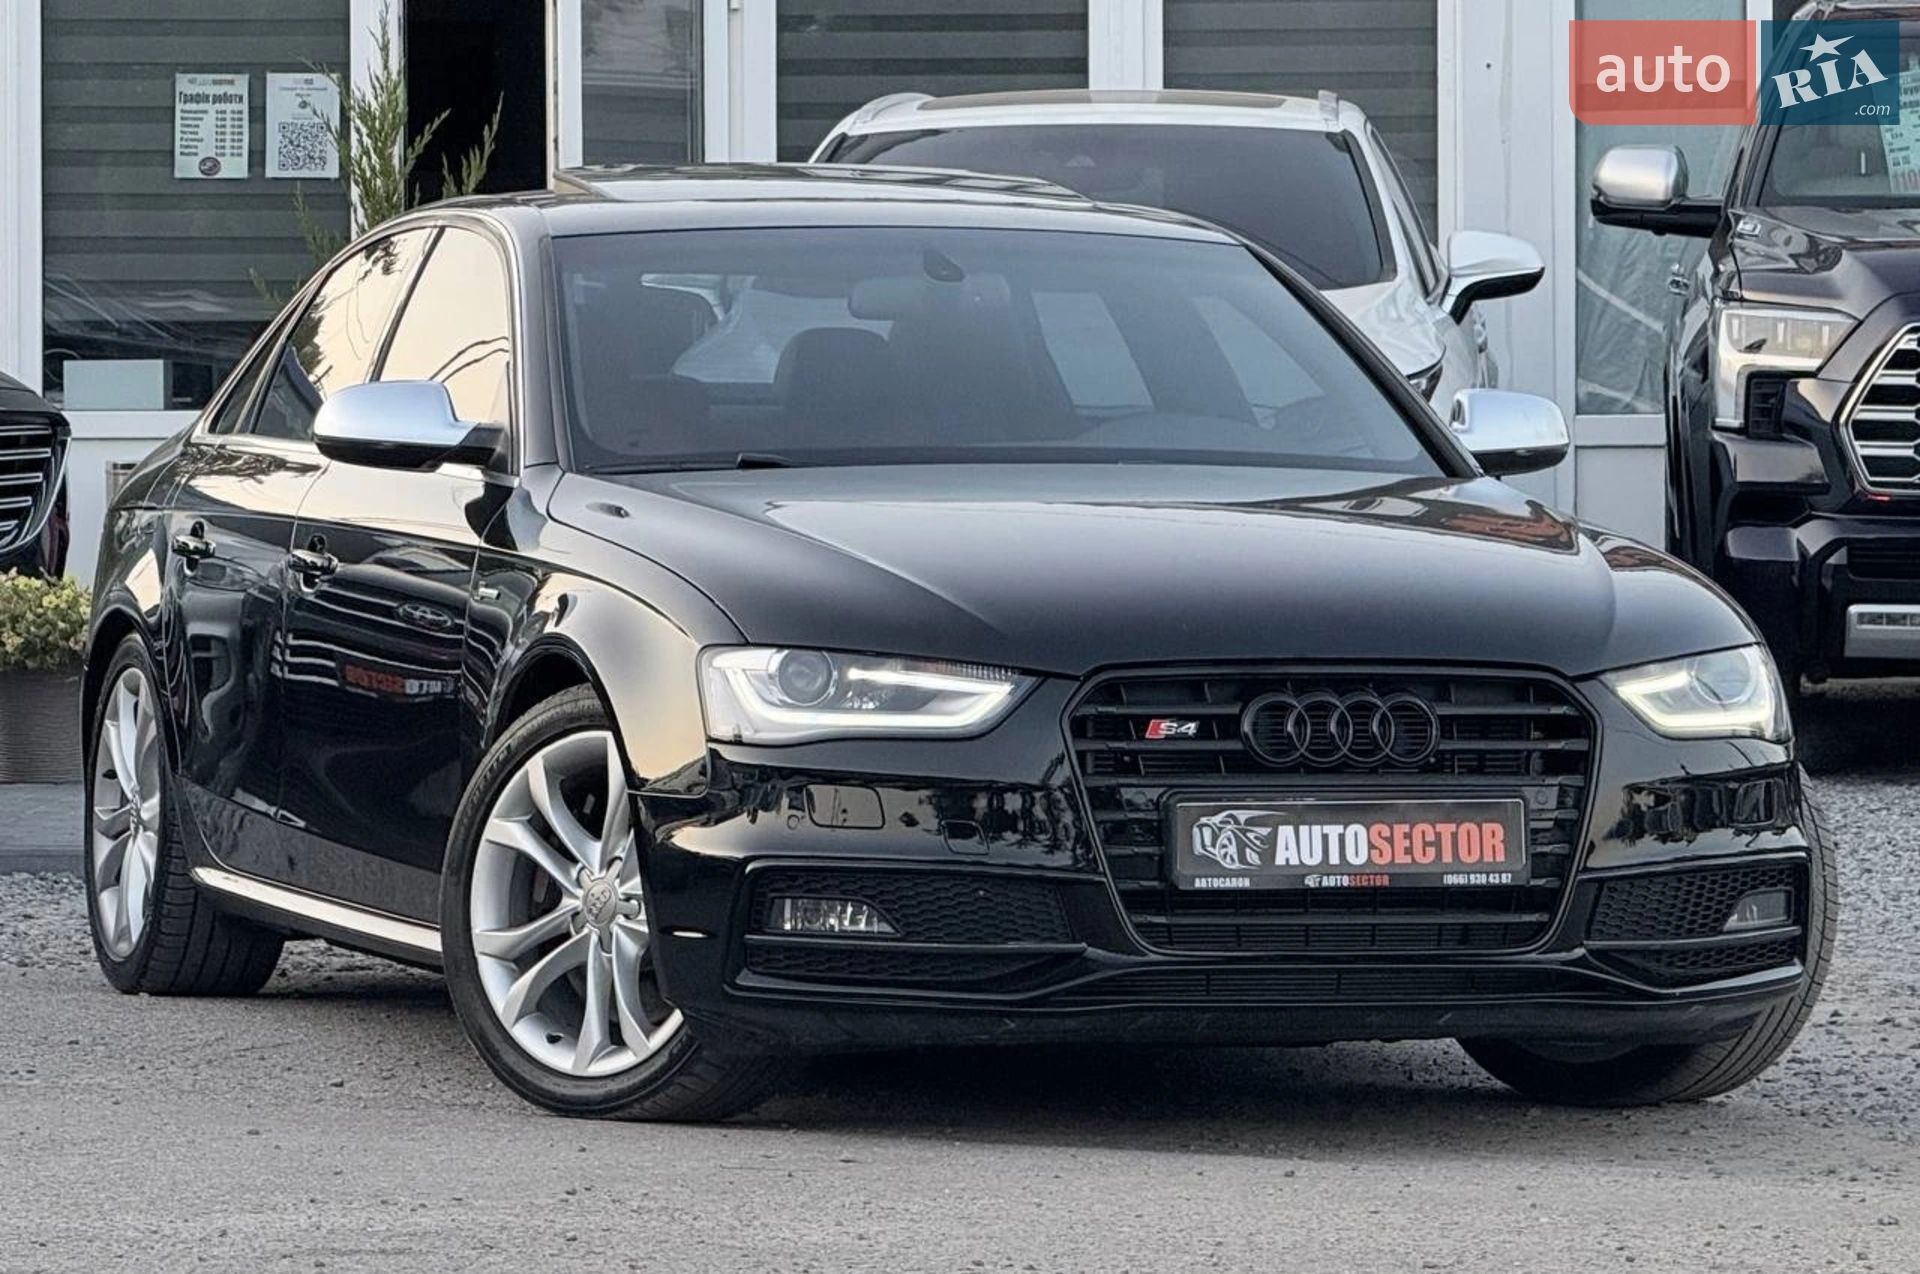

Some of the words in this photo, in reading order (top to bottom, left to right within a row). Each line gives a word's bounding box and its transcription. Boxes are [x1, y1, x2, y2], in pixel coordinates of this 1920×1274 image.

[179, 91, 211, 105] Графік
[212, 91, 244, 105] роботи
[1159, 722, 1197, 735] S4
[1275, 822, 1506, 866] AUTOSECTOR
[1194, 877, 1250, 888] АВТОСАЛОН
[1321, 874, 1390, 888] AUTOSECTOR
